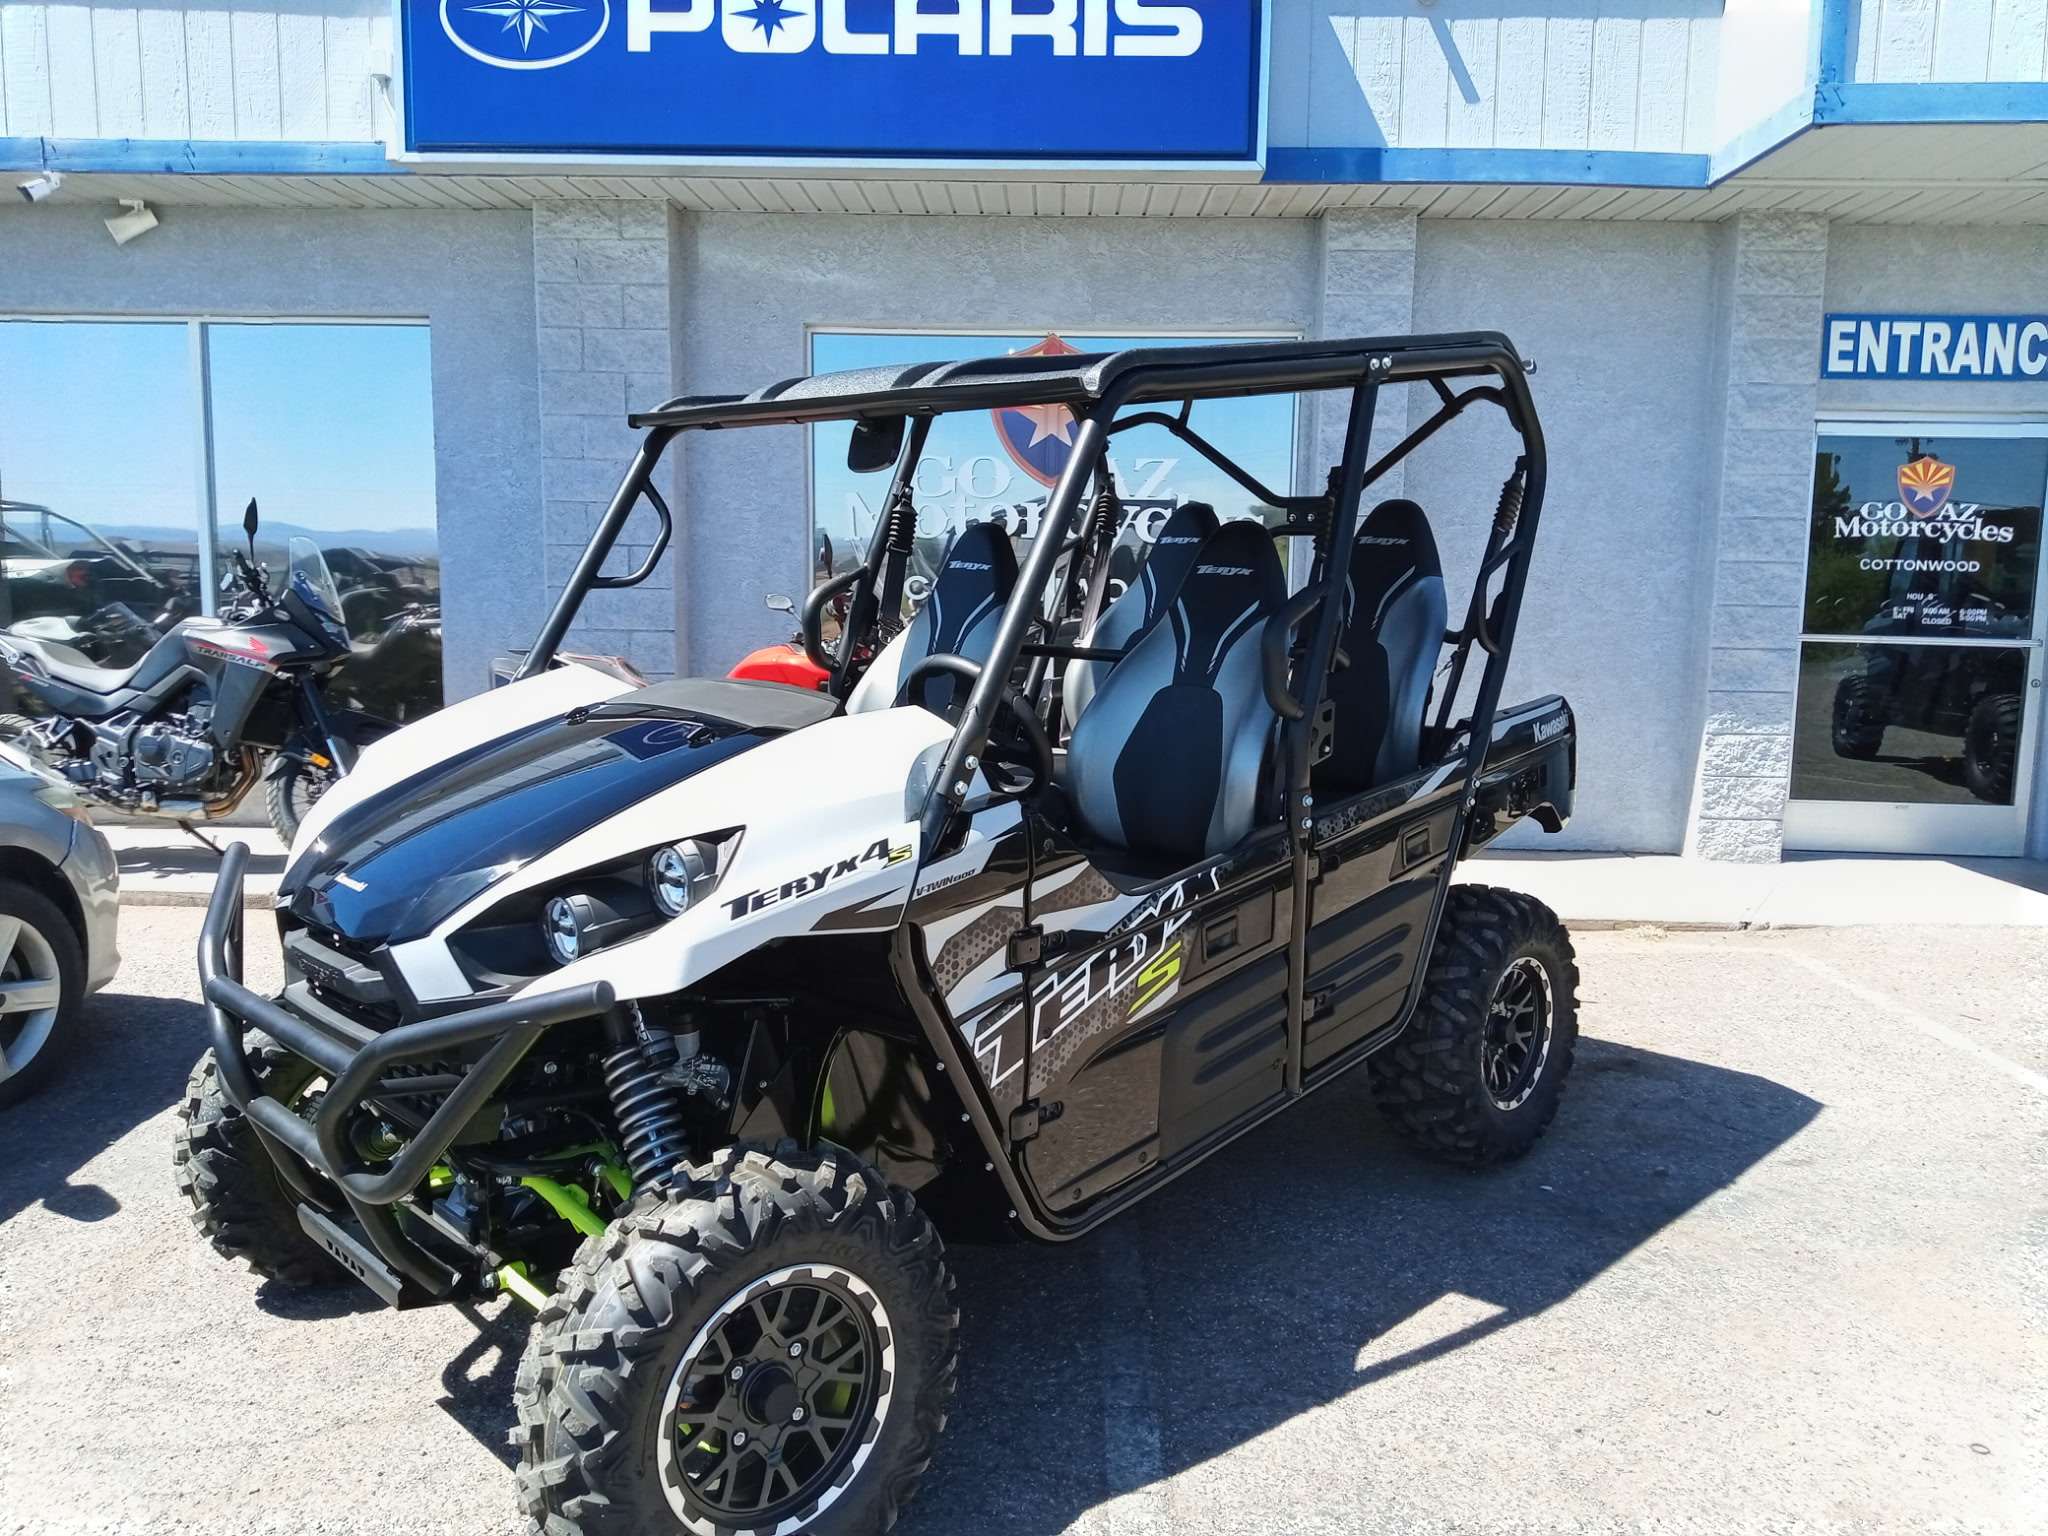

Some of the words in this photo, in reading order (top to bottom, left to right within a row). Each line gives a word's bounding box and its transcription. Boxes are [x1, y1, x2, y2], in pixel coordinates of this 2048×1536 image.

[627, 0, 1204, 57] POLARIS
[912, 456, 1015, 499] GO
[1859, 502, 1908, 520] GO
[1935, 503, 1980, 522] AZ
[1833, 515, 2014, 544] Motorcycles
[1859, 558, 1981, 572] COTTONWOOD
[197, 645, 266, 668] TRANSALP
[1532, 708, 1570, 743] Kawasaki
